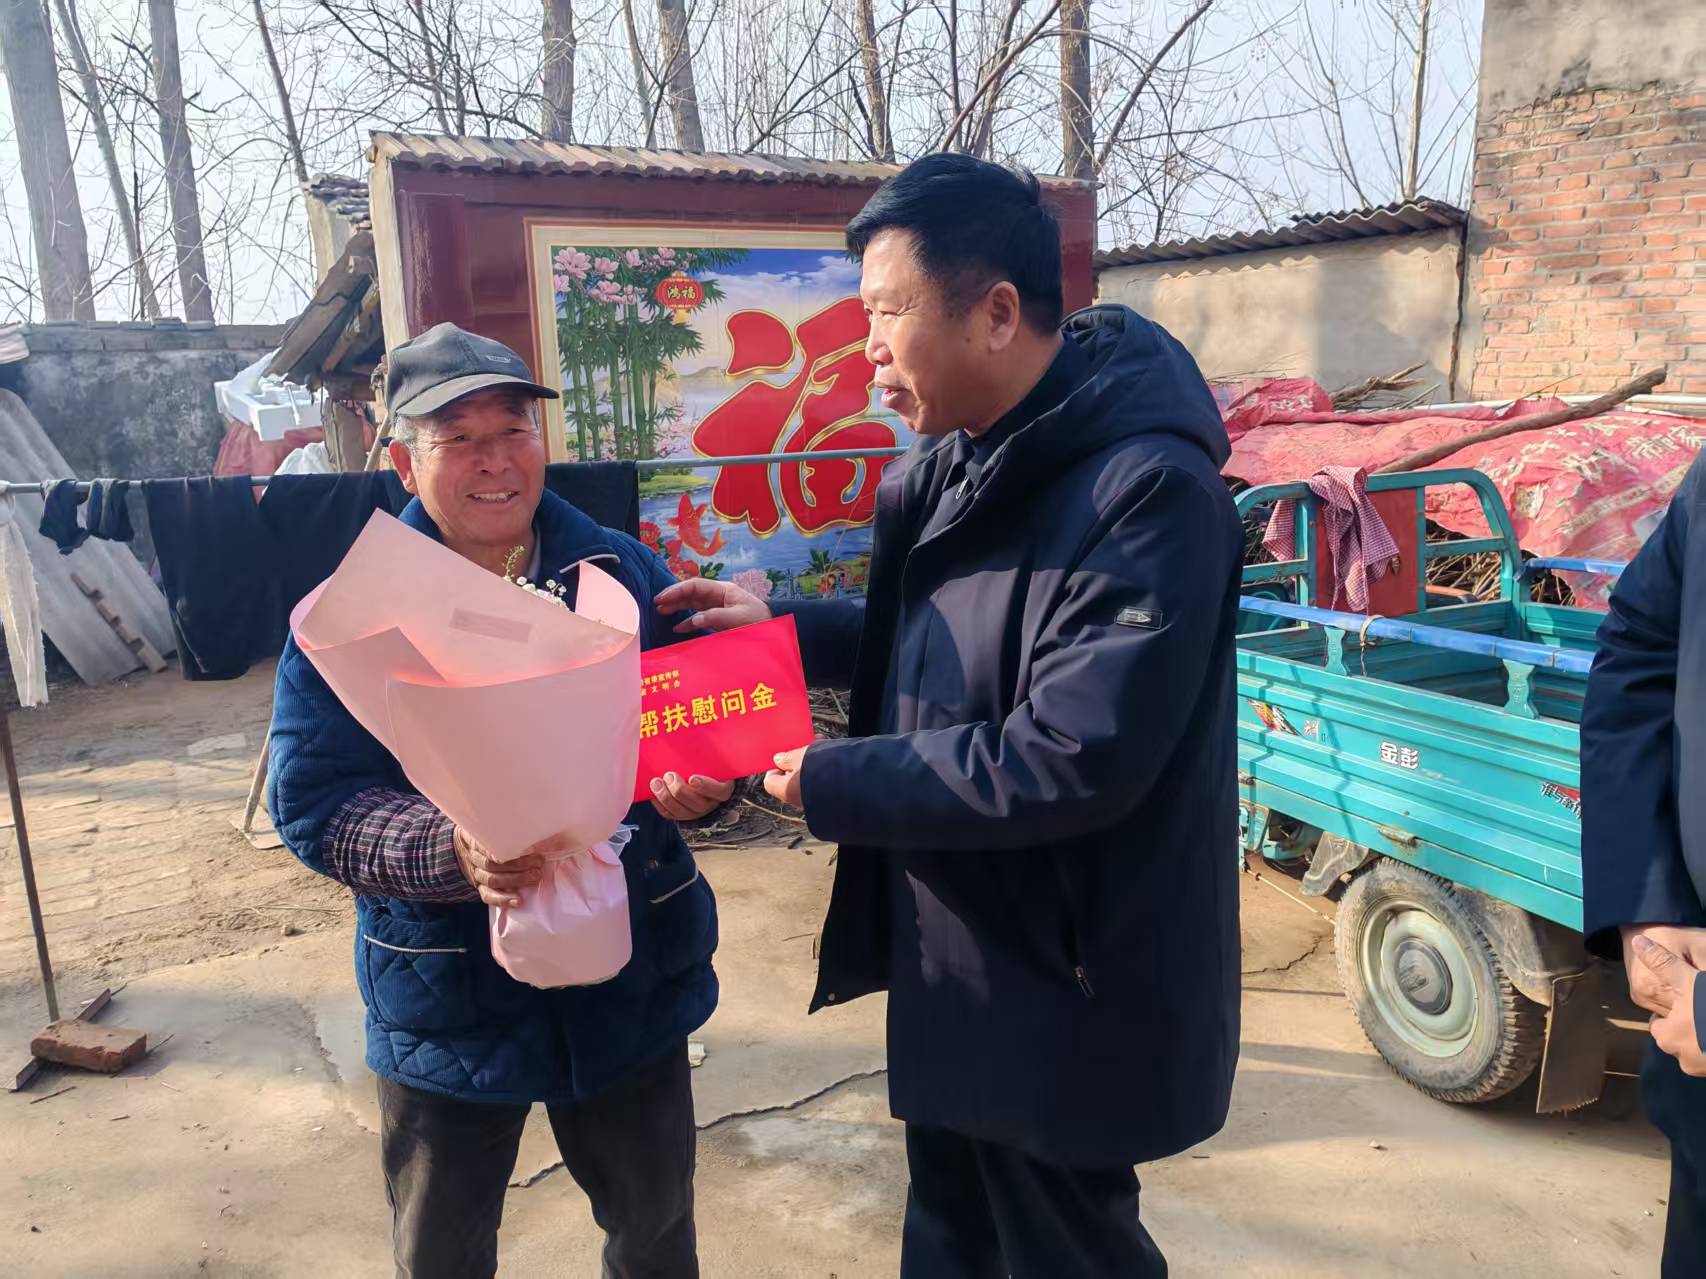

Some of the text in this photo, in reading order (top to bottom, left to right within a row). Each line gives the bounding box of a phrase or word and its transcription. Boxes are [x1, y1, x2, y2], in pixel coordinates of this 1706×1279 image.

[692, 296, 897, 536] 福
[639, 683, 777, 739] 帮扶慰问金
[1380, 741, 1419, 770] 金彭
